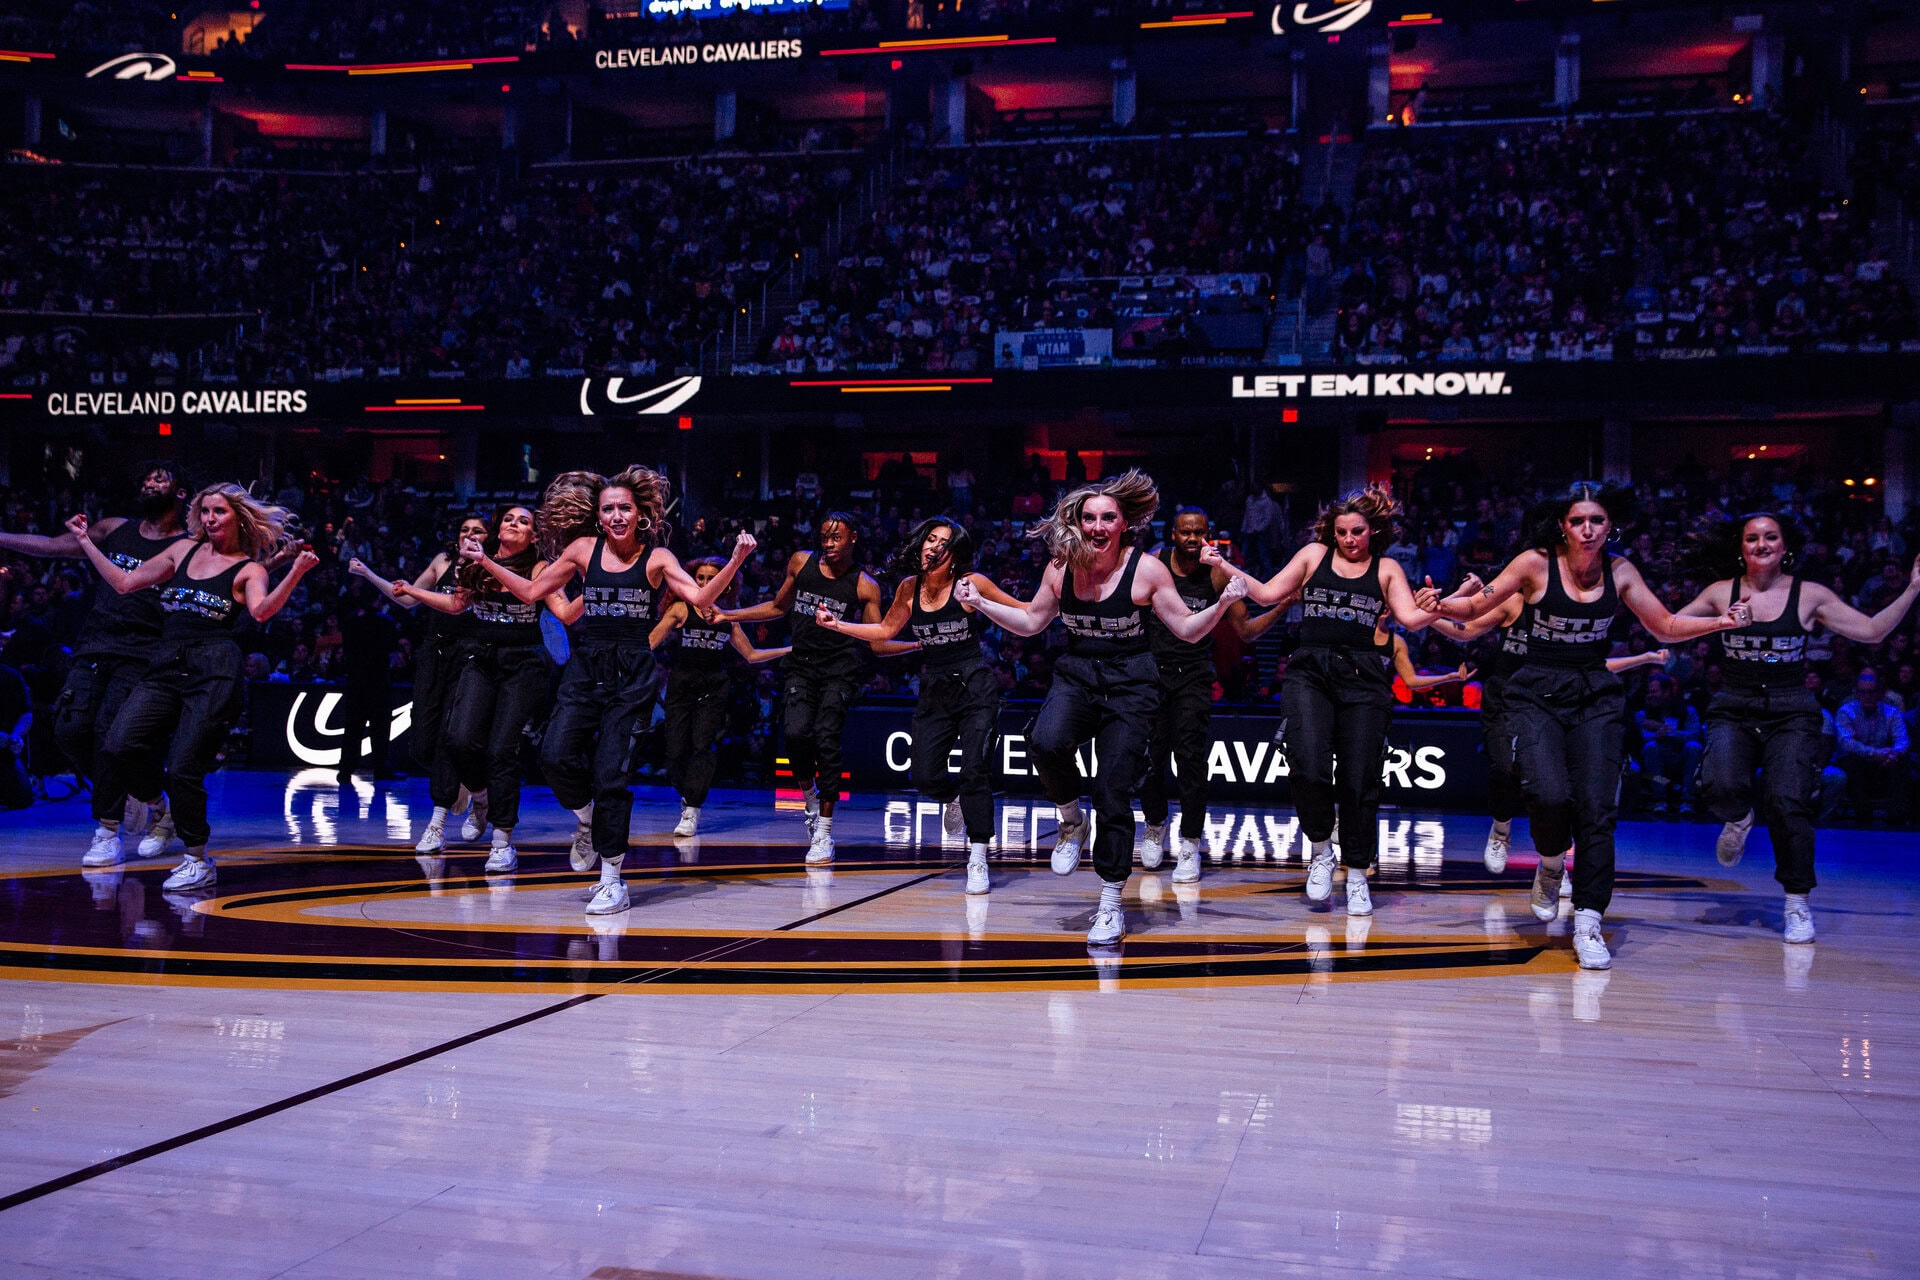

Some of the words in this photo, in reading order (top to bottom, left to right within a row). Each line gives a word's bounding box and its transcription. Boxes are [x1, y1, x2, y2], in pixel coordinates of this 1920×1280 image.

[595, 45, 698, 69] CLEVELAND
[702, 39, 802, 63] CAVALIERS
[1036, 342, 1070, 355] WTAM
[1232, 375, 1306, 398] LET
[1310, 373, 1370, 397] EM
[1373, 371, 1512, 396] KNOW.
[48, 391, 176, 415] CLEVELAND
[182, 390, 308, 414] CAVALIERS
[617, 587, 651, 603] EM
[1303, 587, 1348, 605] LET
[1349, 593, 1384, 615] EM
[936, 617, 969, 634] EM
[1099, 609, 1141, 631] EM
[1533, 608, 1591, 632] LET
